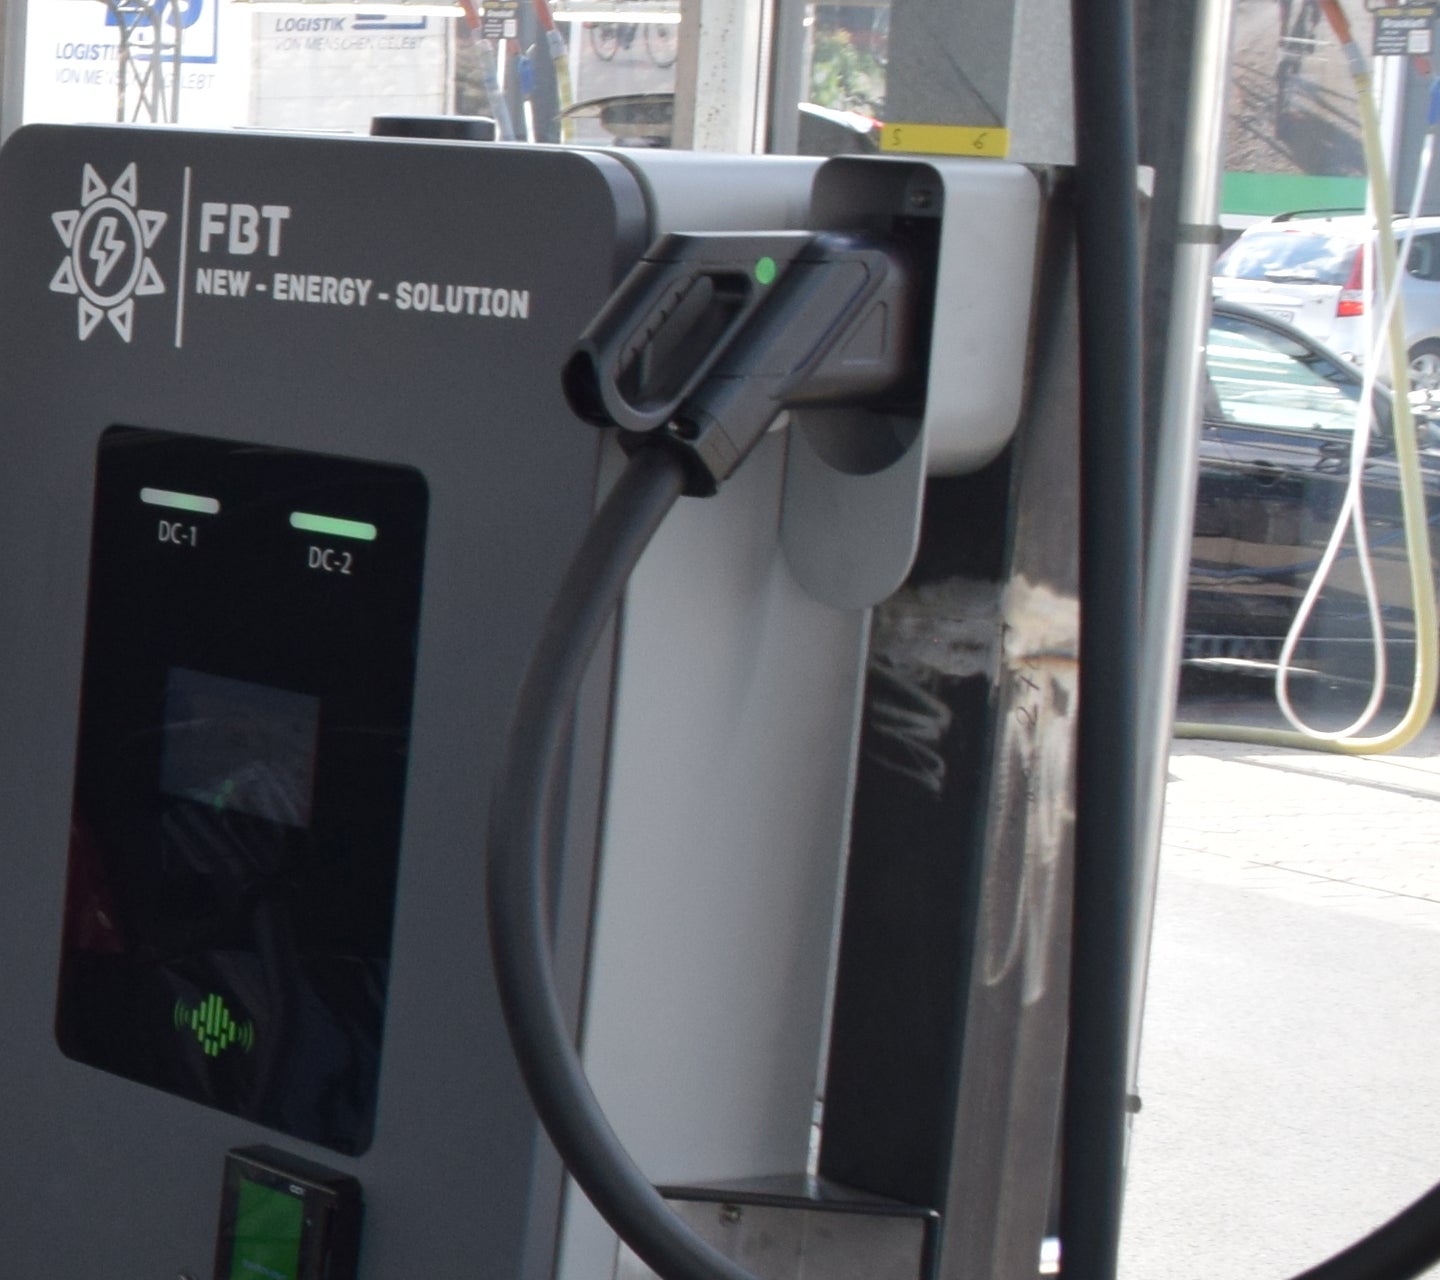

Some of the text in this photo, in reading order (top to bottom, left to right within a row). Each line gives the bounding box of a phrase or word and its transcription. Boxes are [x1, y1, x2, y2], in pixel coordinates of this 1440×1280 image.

[274, 16, 347, 33] LOGISTIK
[55, 41, 121, 61] LOGISTI
[972, 131, 989, 150] 6
[198, 201, 292, 257] FBT
[195, 267, 251, 297] NEW
[272, 272, 373, 306] ENERGY
[394, 281, 529, 320] SOLUTION
[157, 519, 198, 547] DC-1
[307, 545, 353, 575] DC-2
